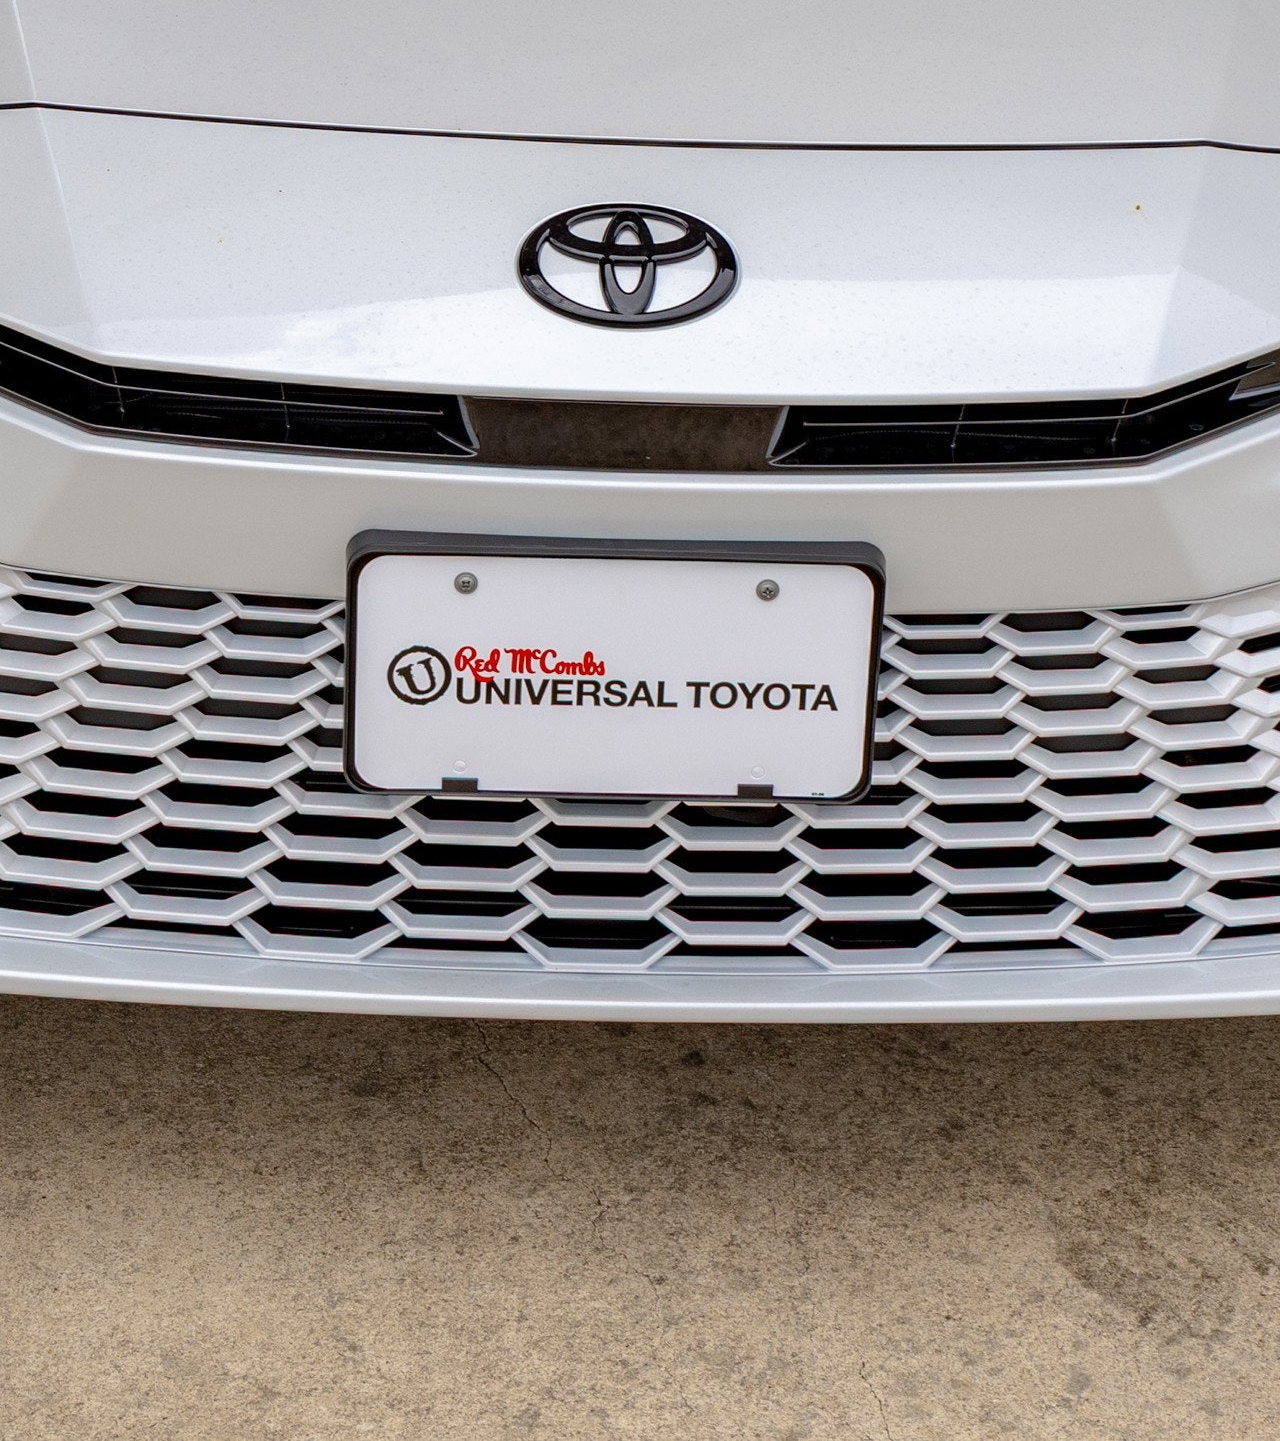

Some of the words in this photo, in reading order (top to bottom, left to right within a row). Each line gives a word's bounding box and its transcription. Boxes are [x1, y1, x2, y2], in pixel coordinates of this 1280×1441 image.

[454, 646, 501, 683] Red
[504, 647, 606, 677] McCombs
[456, 677, 678, 708] UNIVERSAL
[686, 680, 839, 712] TOYOTA
